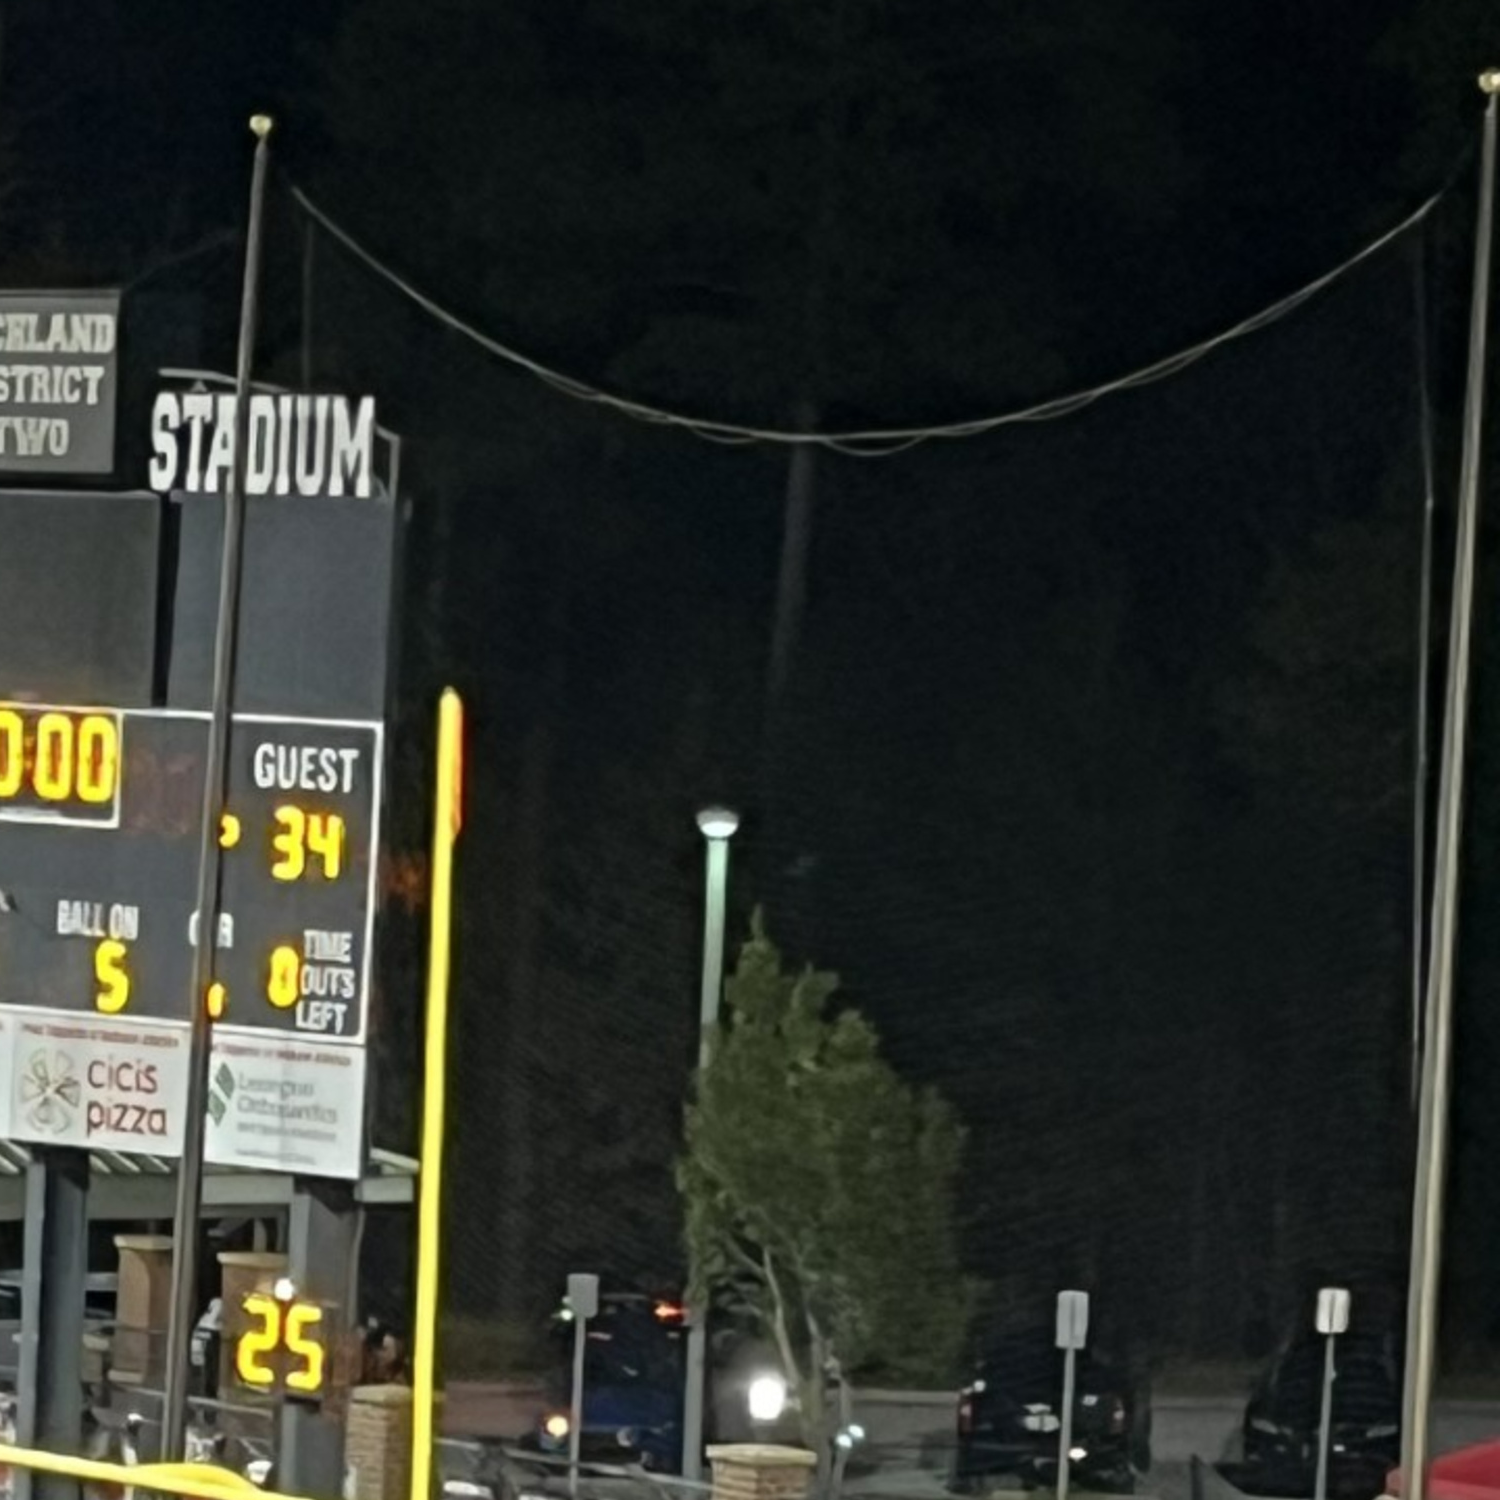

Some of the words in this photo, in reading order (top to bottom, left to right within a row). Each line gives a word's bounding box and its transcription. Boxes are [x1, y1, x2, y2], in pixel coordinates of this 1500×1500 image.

[149, 392, 375, 498] STADIUM
[253, 742, 360, 793] GUEST
[271, 805, 344, 880] 34
[57, 900, 105, 937] BALL
[109, 903, 139, 940] ON
[95, 939, 129, 1013] 5
[268, 945, 300, 1008] 0
[300, 964, 355, 998] OUTS
[295, 1001, 348, 1035] LEFT
[86, 1098, 167, 1139] pizza
[236, 1296, 324, 1391] 25
